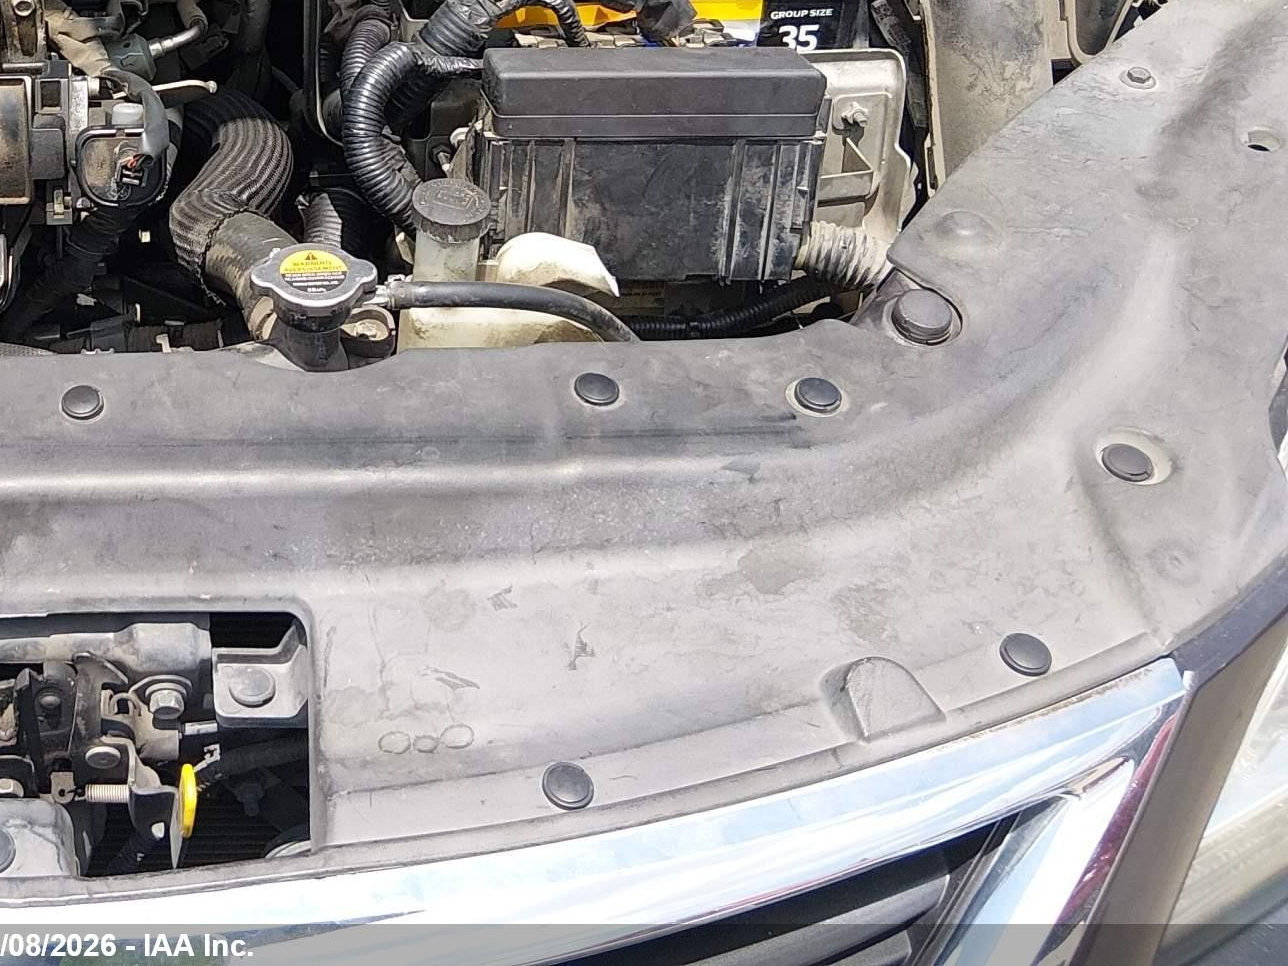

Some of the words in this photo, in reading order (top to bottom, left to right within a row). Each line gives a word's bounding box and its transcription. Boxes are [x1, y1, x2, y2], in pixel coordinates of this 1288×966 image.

[770, 10, 809, 20] GROUP
[809, 9, 834, 17] SIZE
[778, 24, 820, 51] 35
